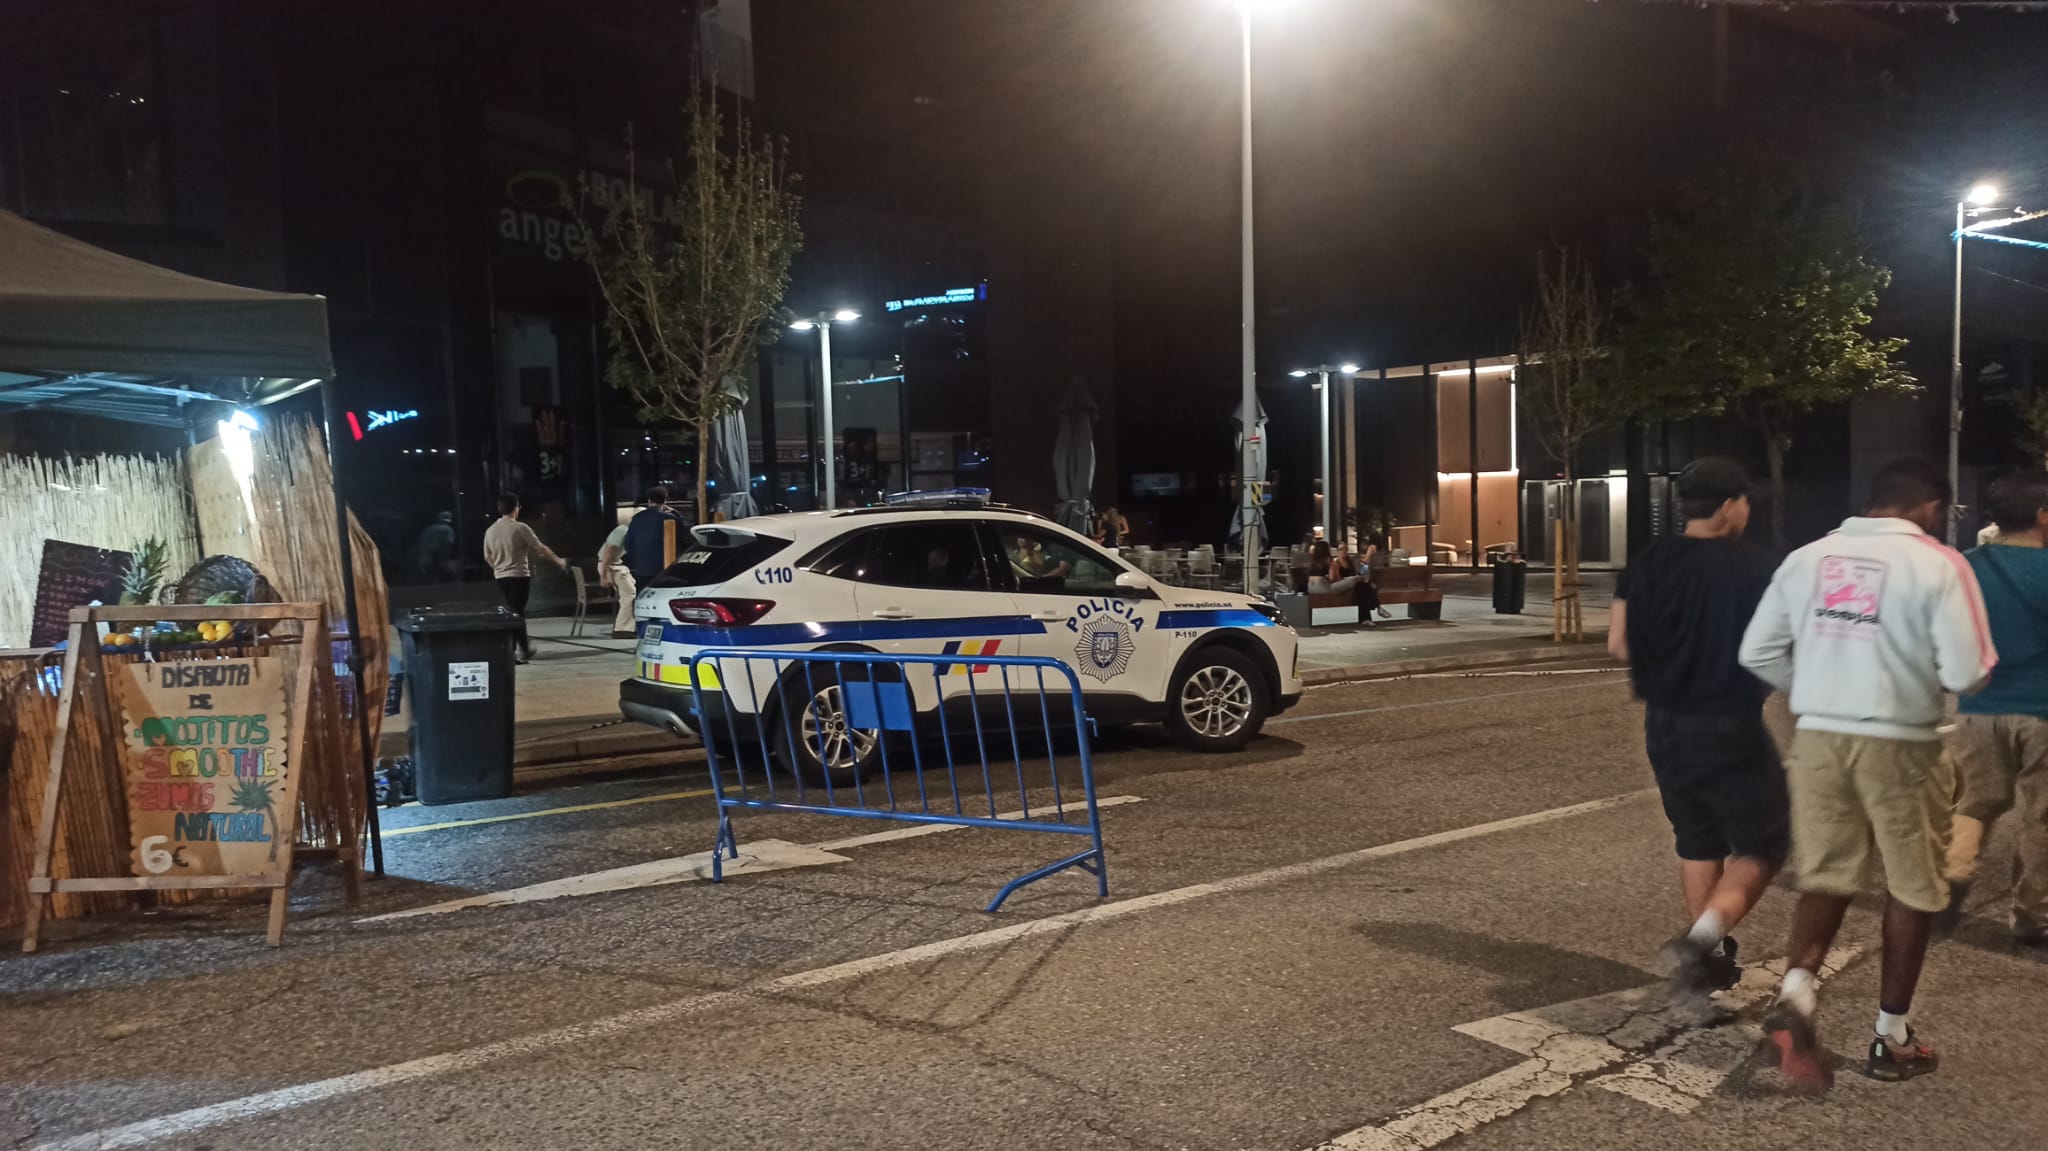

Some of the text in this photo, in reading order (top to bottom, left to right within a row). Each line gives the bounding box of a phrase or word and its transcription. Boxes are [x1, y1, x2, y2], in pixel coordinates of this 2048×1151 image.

[765, 567, 793, 584] 110
[1066, 598, 1145, 633] POLICIA
[1175, 630, 1198, 639] P-110
[188, 693, 214, 710] DE
[142, 714, 270, 747] MOJITOS
[143, 746, 278, 779] SMOOTHIE
[137, 782, 215, 812] ZUMOS
[174, 812, 272, 843] NATURAL
